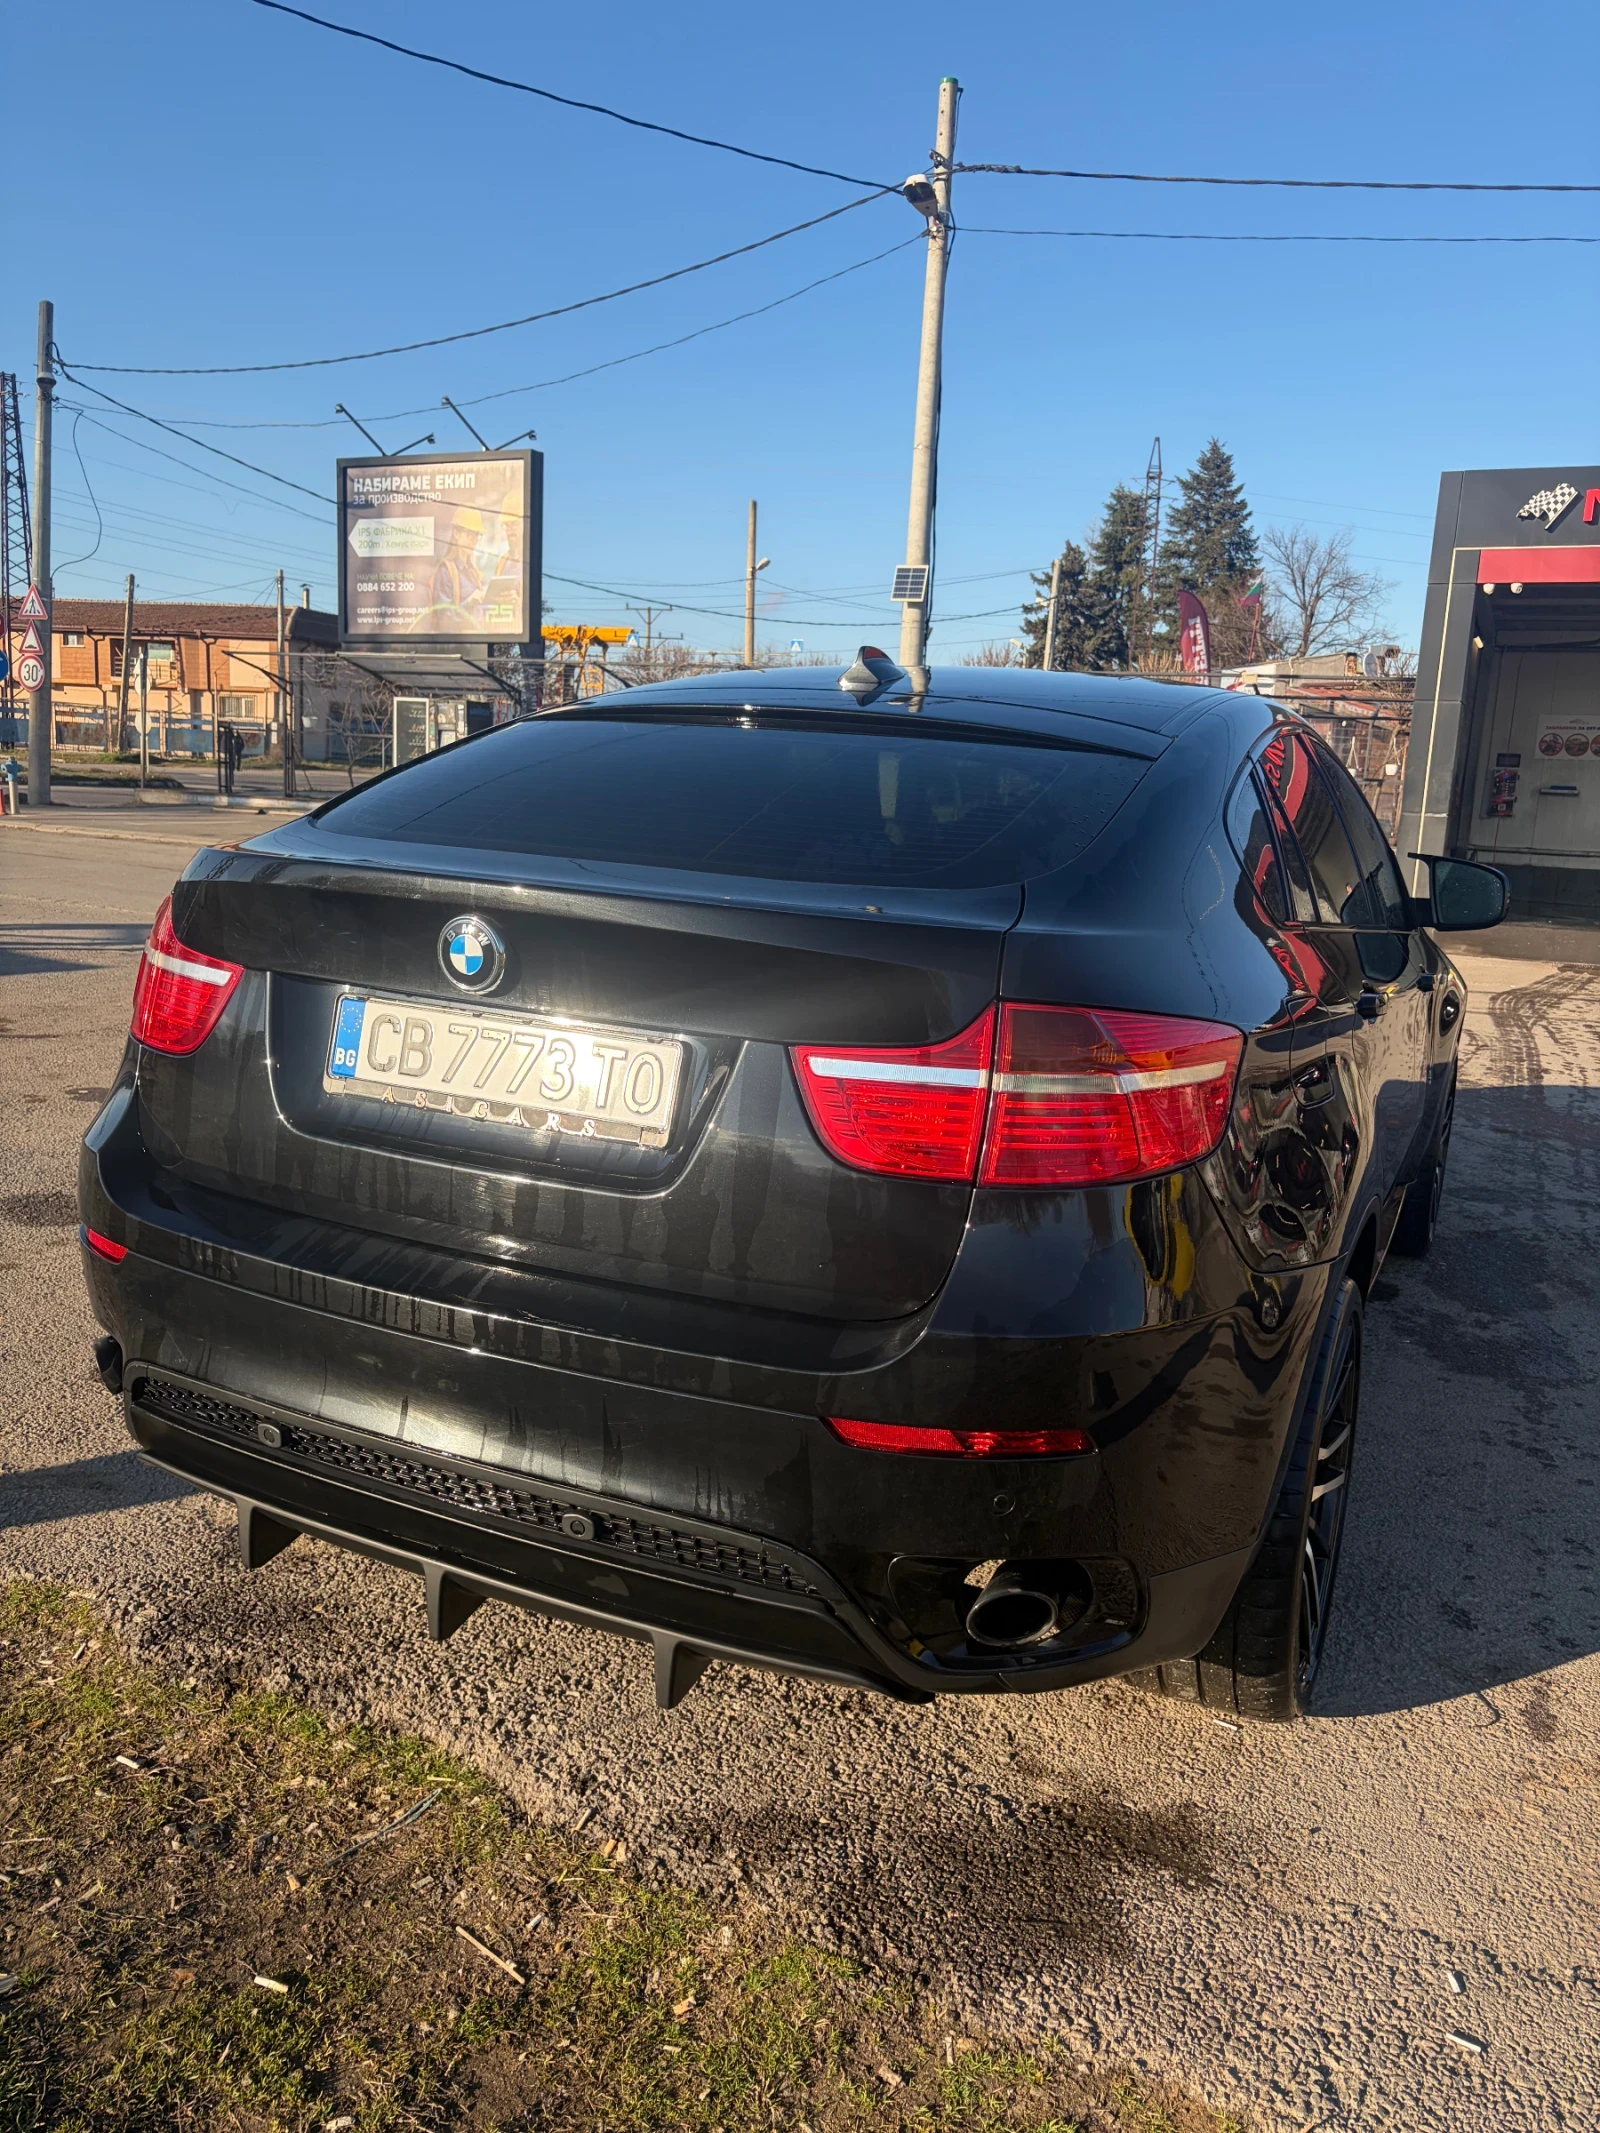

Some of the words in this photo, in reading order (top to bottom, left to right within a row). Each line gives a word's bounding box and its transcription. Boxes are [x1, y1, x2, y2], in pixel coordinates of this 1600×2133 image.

[353, 475, 431, 493] НАБИРАМЕ
[435, 473, 476, 490] ЕКИП
[353, 494, 366, 505] за
[368, 492, 442, 507] производство
[358, 527, 371, 537] IPS
[373, 525, 412, 537] ФАБРИКА
[356, 582, 379, 592] 0884
[380, 582, 396, 592] 652
[397, 581, 415, 592] 200
[23, 664, 38, 682] 30
[446, 923, 491, 947] BMW
[334, 1047, 356, 1067] BG
[367, 1012, 434, 1078] CB
[441, 1022, 576, 1102] 7773
